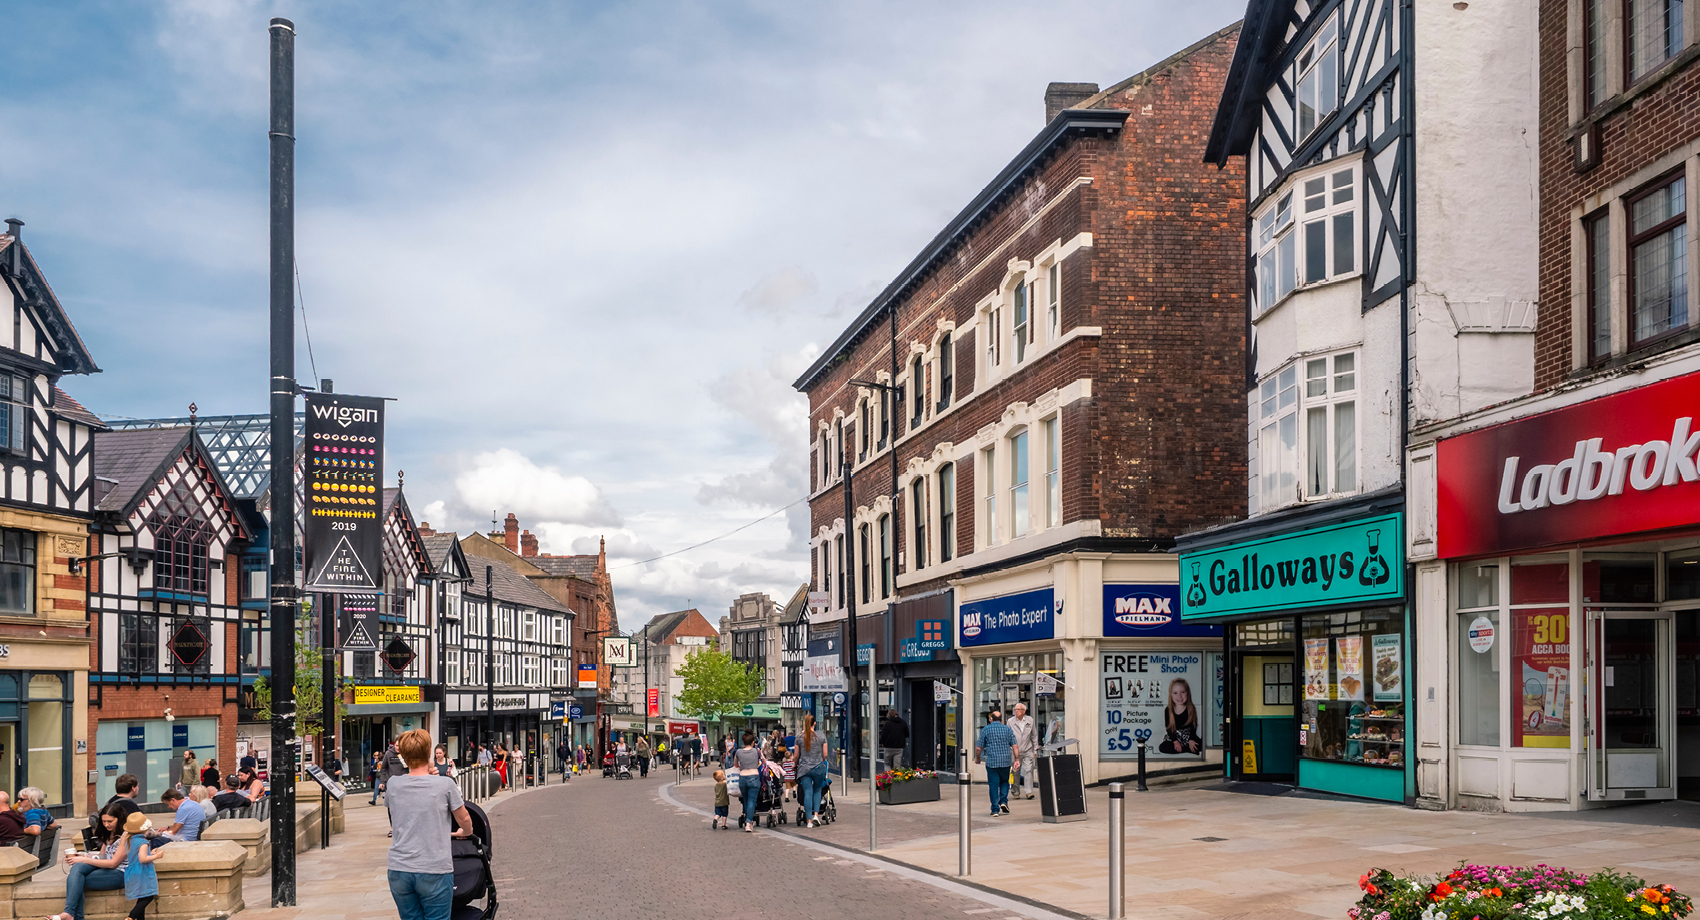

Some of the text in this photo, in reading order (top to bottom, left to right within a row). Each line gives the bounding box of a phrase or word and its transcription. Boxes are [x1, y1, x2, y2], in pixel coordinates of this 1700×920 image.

[312, 400, 378, 428] wigan
[1498, 417, 1700, 514] Ladbrok
[332, 522, 357, 531] 2019
[326, 573, 364, 581] WITHIN
[1209, 551, 1355, 596] Galloways
[1115, 597, 1172, 614] MAX
[963, 612, 981, 628] MAX
[984, 606, 1048, 630] The Photo Expert
[1531, 644, 1570, 655] ACCA BOO
[823, 662, 836, 677] News
[1104, 655, 1199, 673] FREE Mini Photo
[1160, 663, 1188, 673] Shoot
[356, 688, 386, 697] DESIGNER
[385, 693, 420, 702] CLEARANCE
[1106, 709, 1122, 725] 10
[1122, 717, 1152, 725] Package
[1104, 726, 1118, 735] Only
